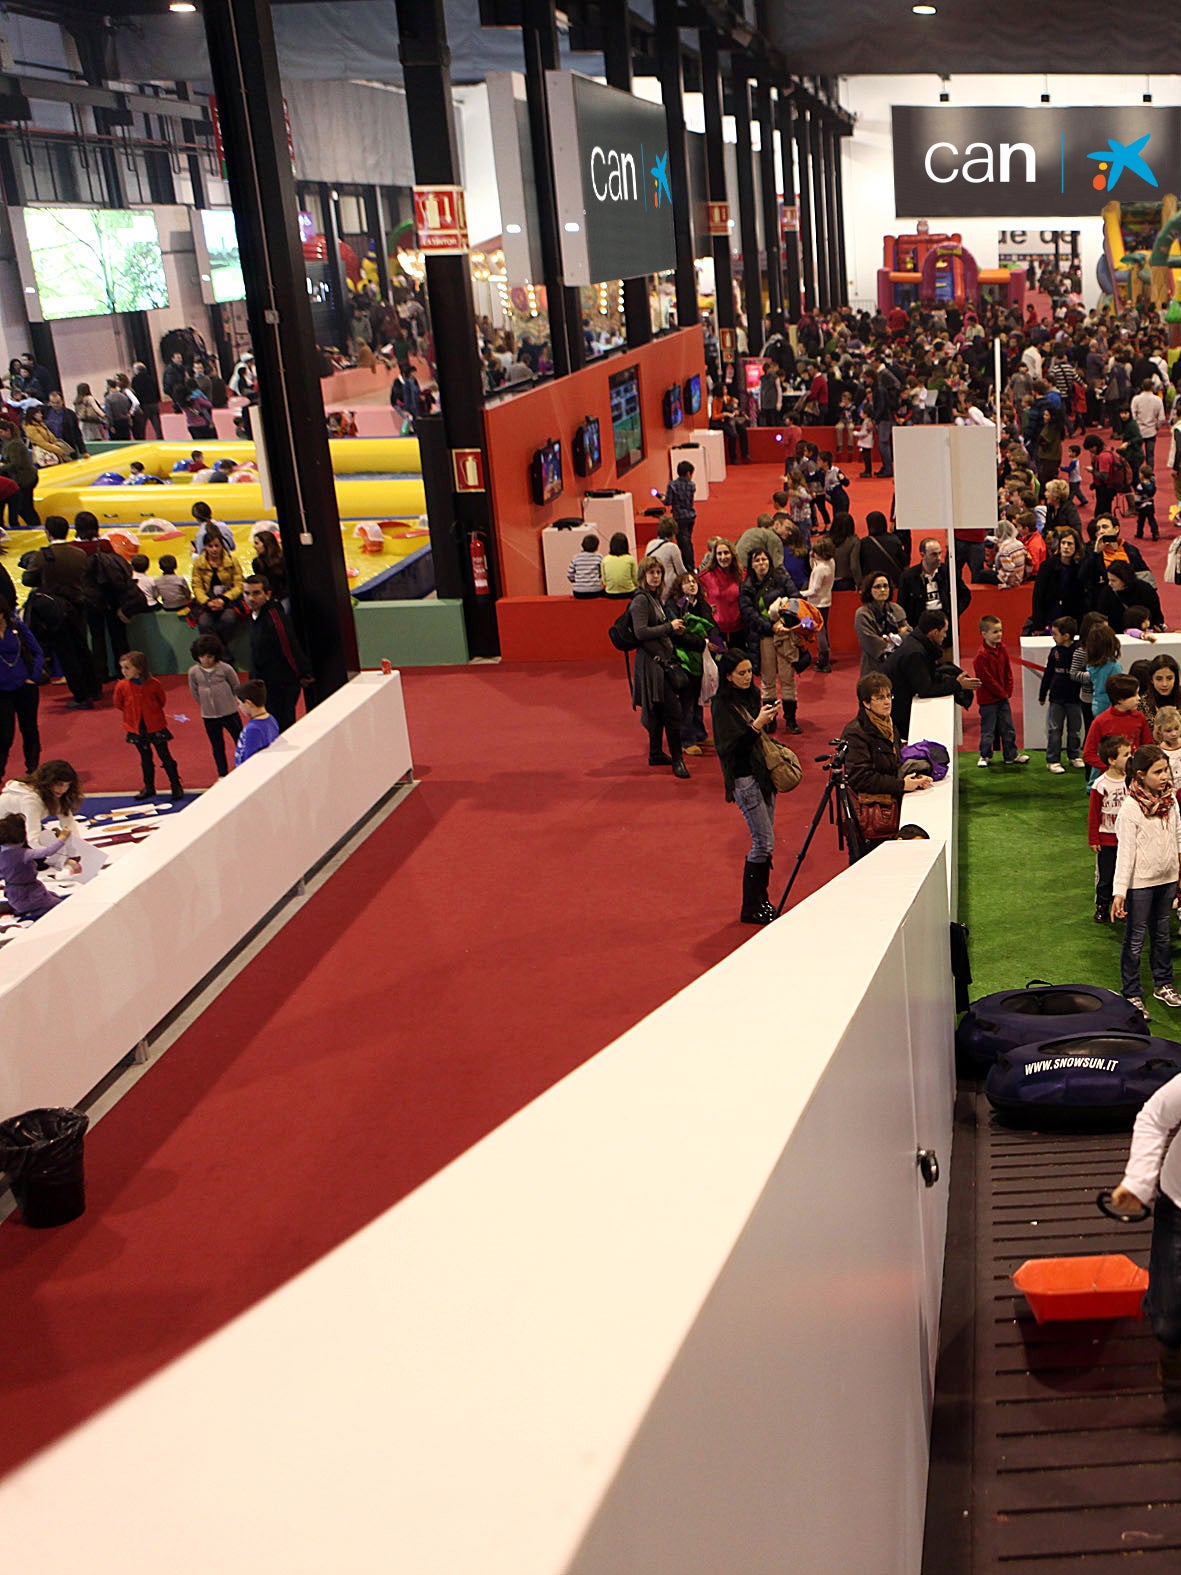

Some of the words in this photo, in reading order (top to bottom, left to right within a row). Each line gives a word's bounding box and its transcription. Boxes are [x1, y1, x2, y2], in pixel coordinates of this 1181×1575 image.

[590, 146, 638, 202] can
[925, 142, 1037, 183] can
[1024, 1057, 1119, 1076] WWW.SNOWSUN.IT
